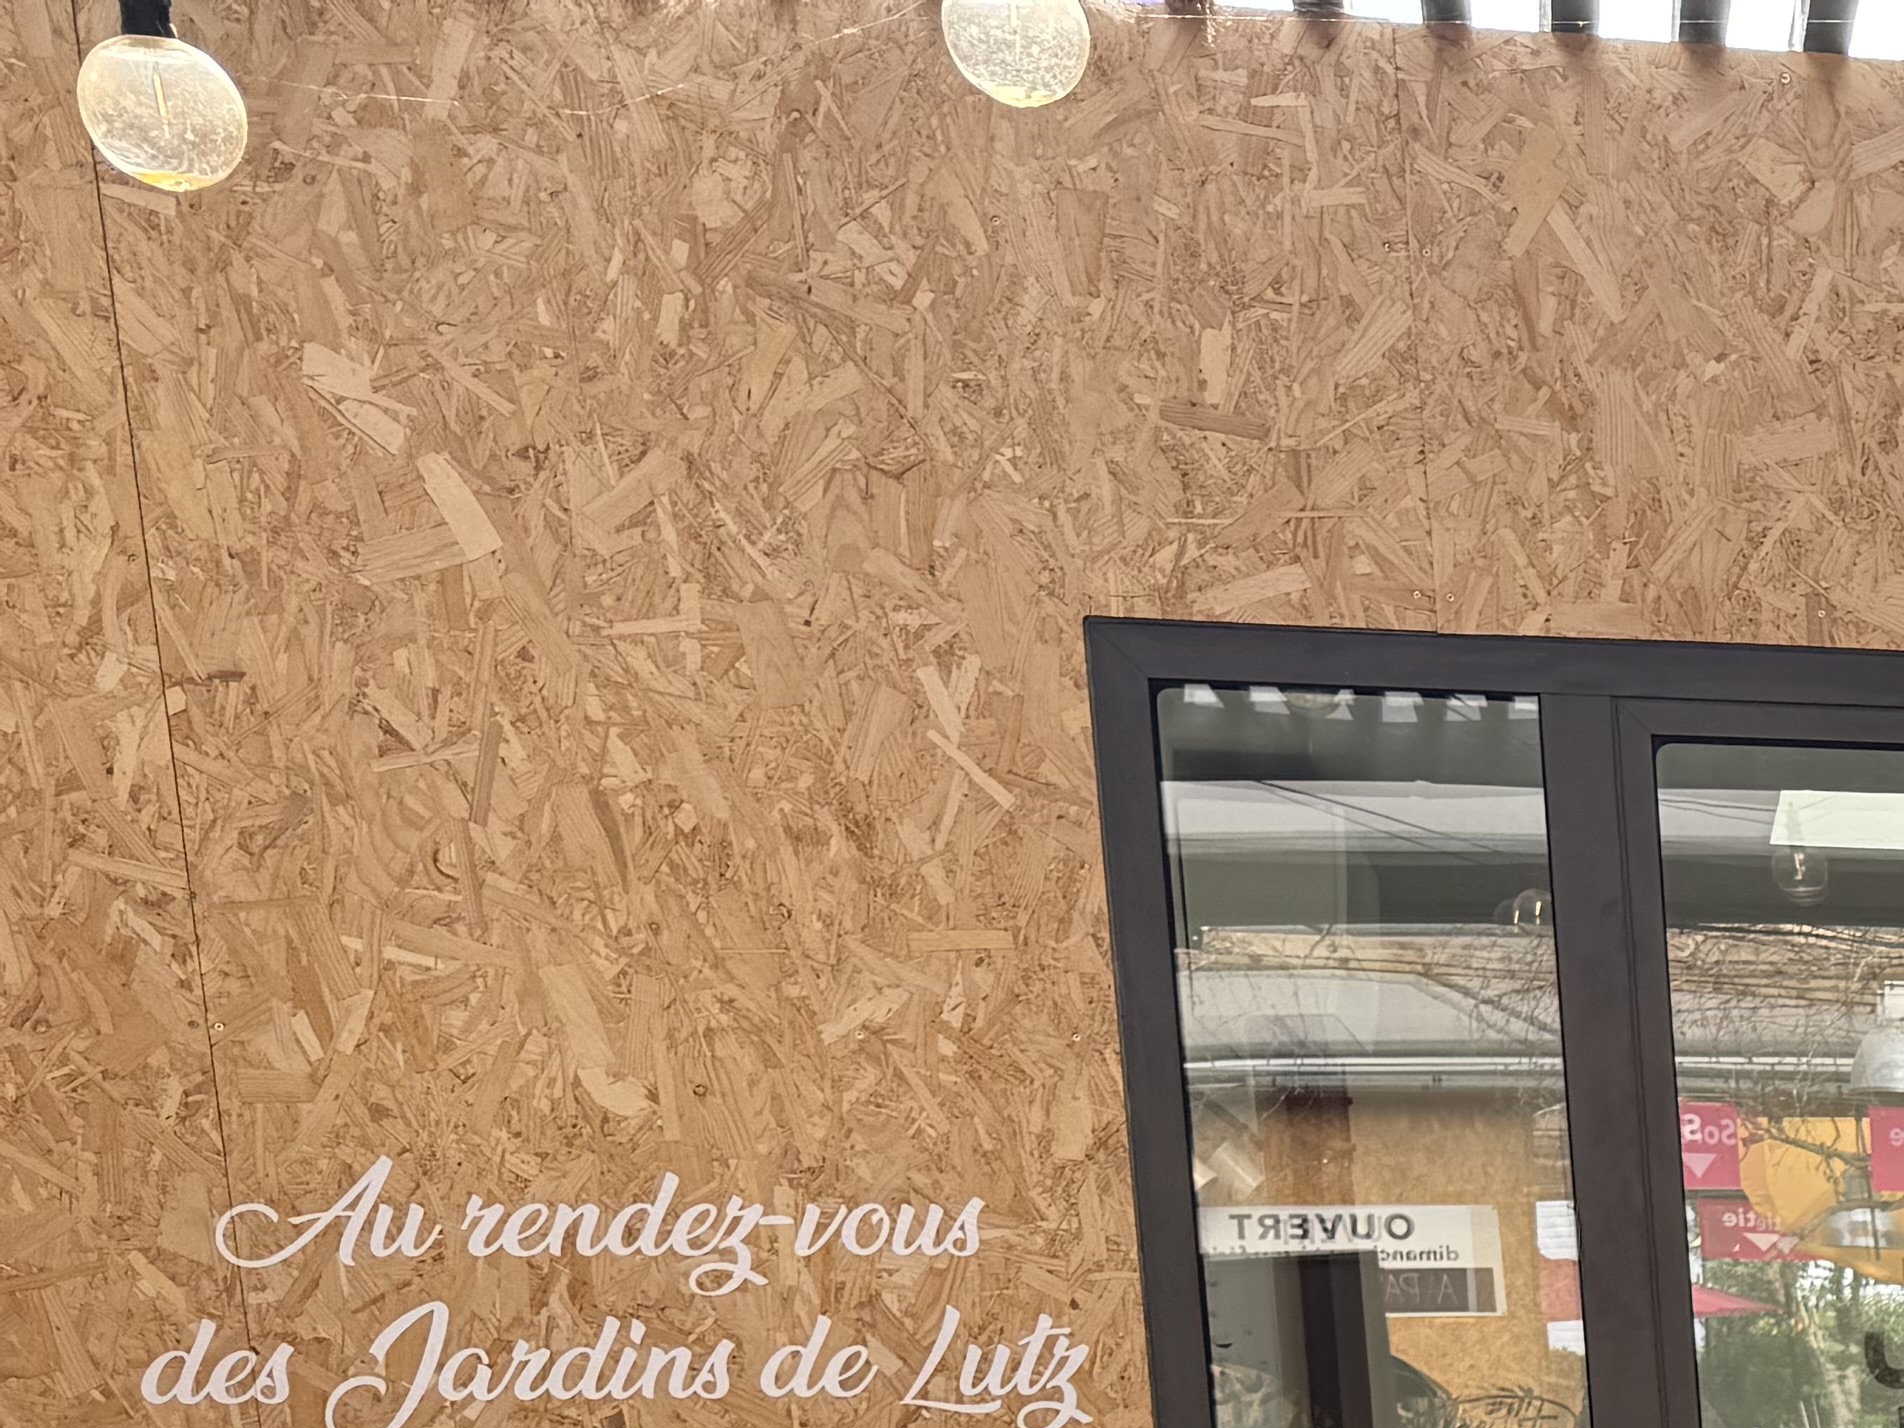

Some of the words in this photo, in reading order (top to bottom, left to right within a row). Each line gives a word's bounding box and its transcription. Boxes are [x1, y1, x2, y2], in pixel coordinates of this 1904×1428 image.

[216, 1155, 440, 1268] Au
[461, 1172, 984, 1296] rendez-vous
[141, 1322, 293, 1407] des
[760, 1314, 874, 1399] de
